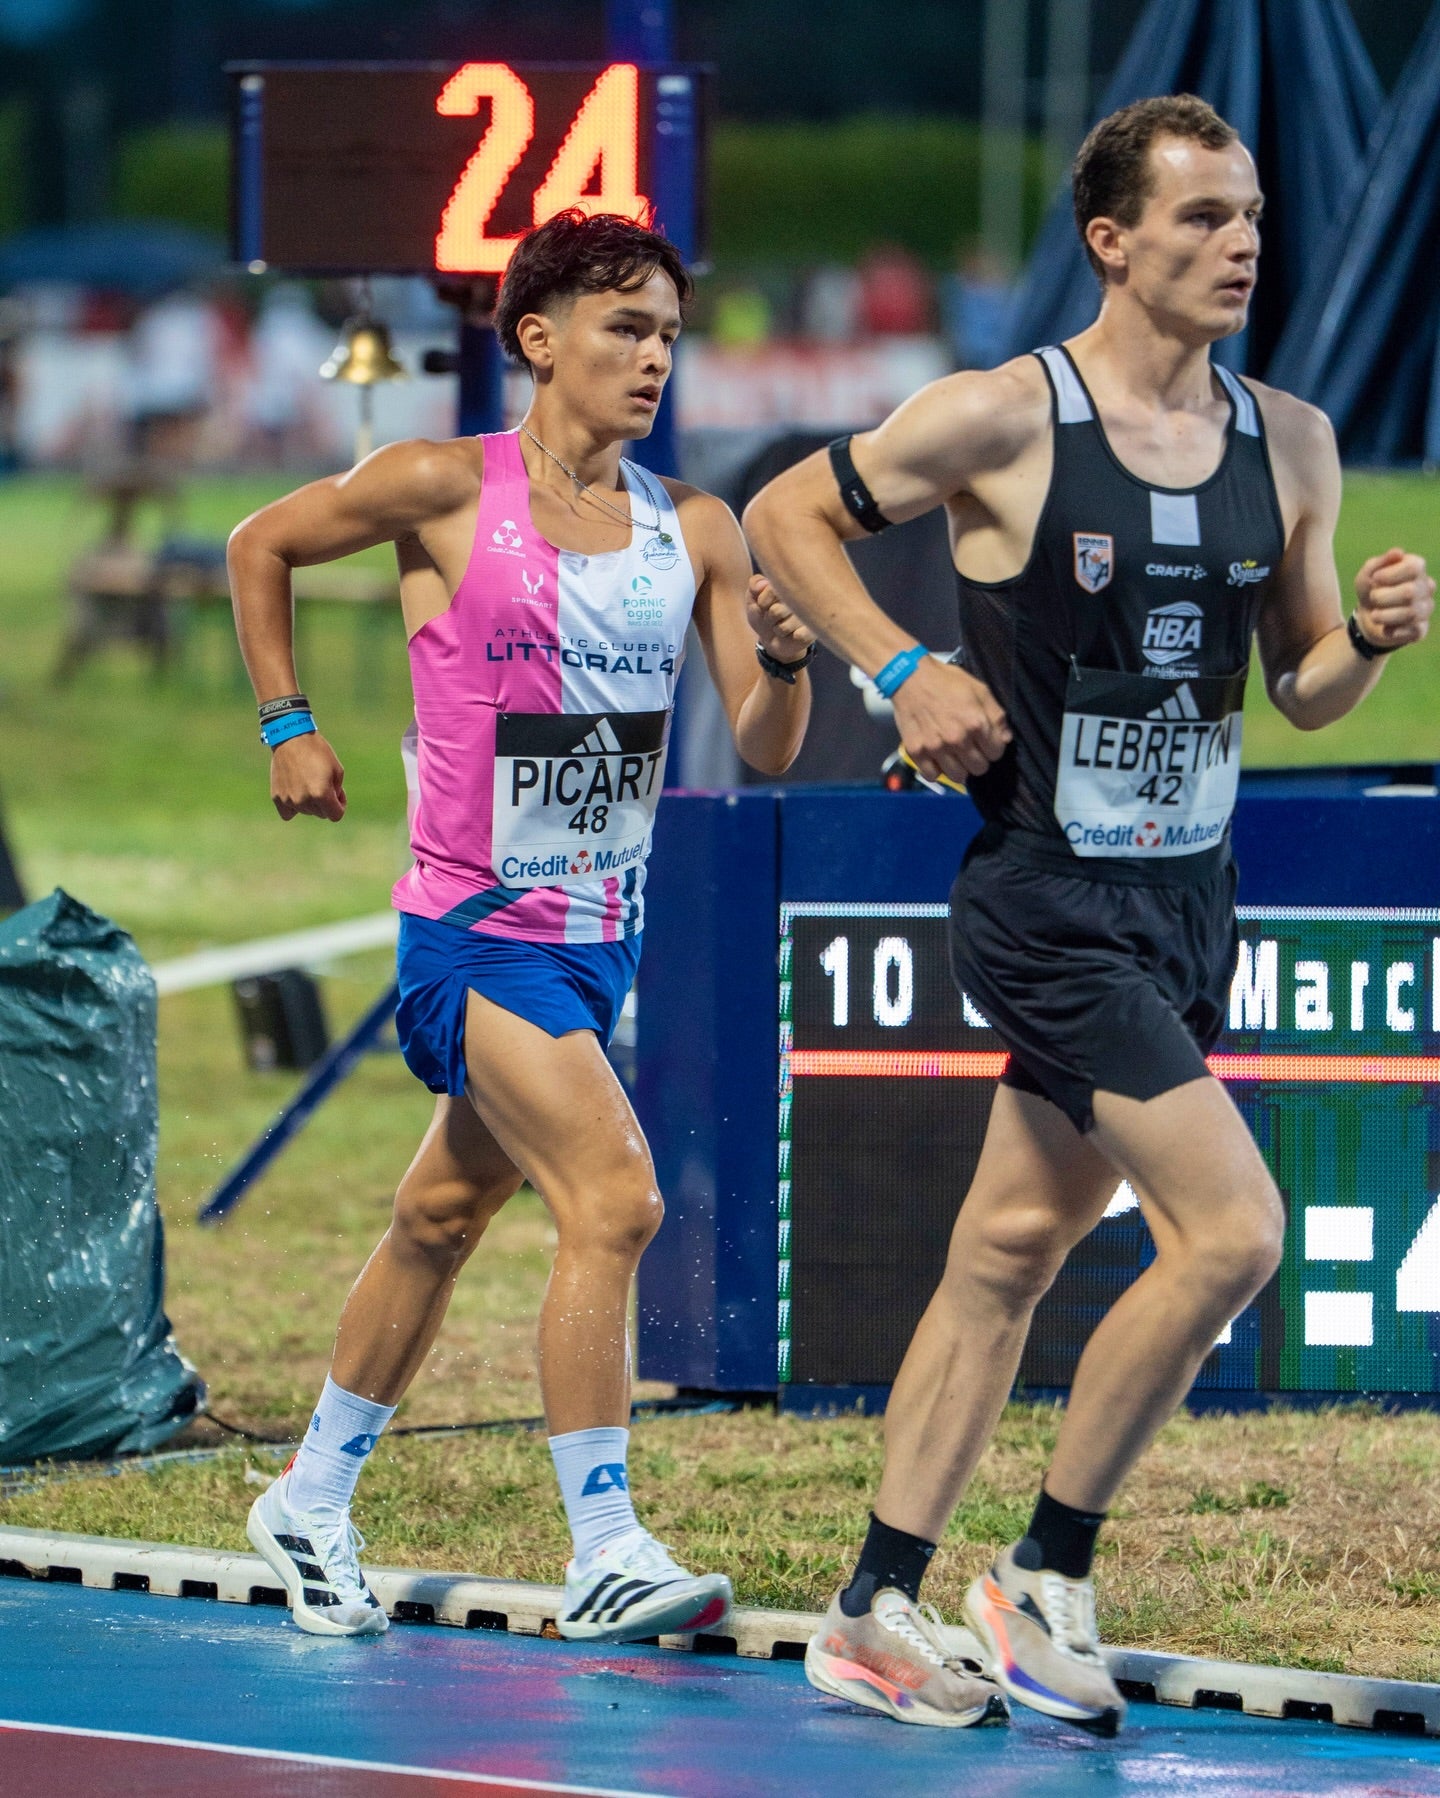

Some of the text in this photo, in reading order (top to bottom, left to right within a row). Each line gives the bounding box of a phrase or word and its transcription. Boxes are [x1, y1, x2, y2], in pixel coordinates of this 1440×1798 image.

[436, 63, 651, 272] 24
[1146, 563, 1193, 577] CRAFT
[624, 598, 666, 608] PORNIC
[627, 610, 663, 620] agglo
[495, 628, 588, 648] ATHLETIC
[599, 642, 660, 653] CLUBS
[1142, 616, 1202, 649] HBA
[486, 642, 652, 675] LITTORAL
[512, 749, 664, 807] PICART
[1136, 775, 1182, 806] 42
[568, 805, 609, 835] 48
[1065, 817, 1225, 847] Crédit Mutuel
[501, 837, 646, 879] Crédit Mutuel
[819, 936, 912, 1027] 10
